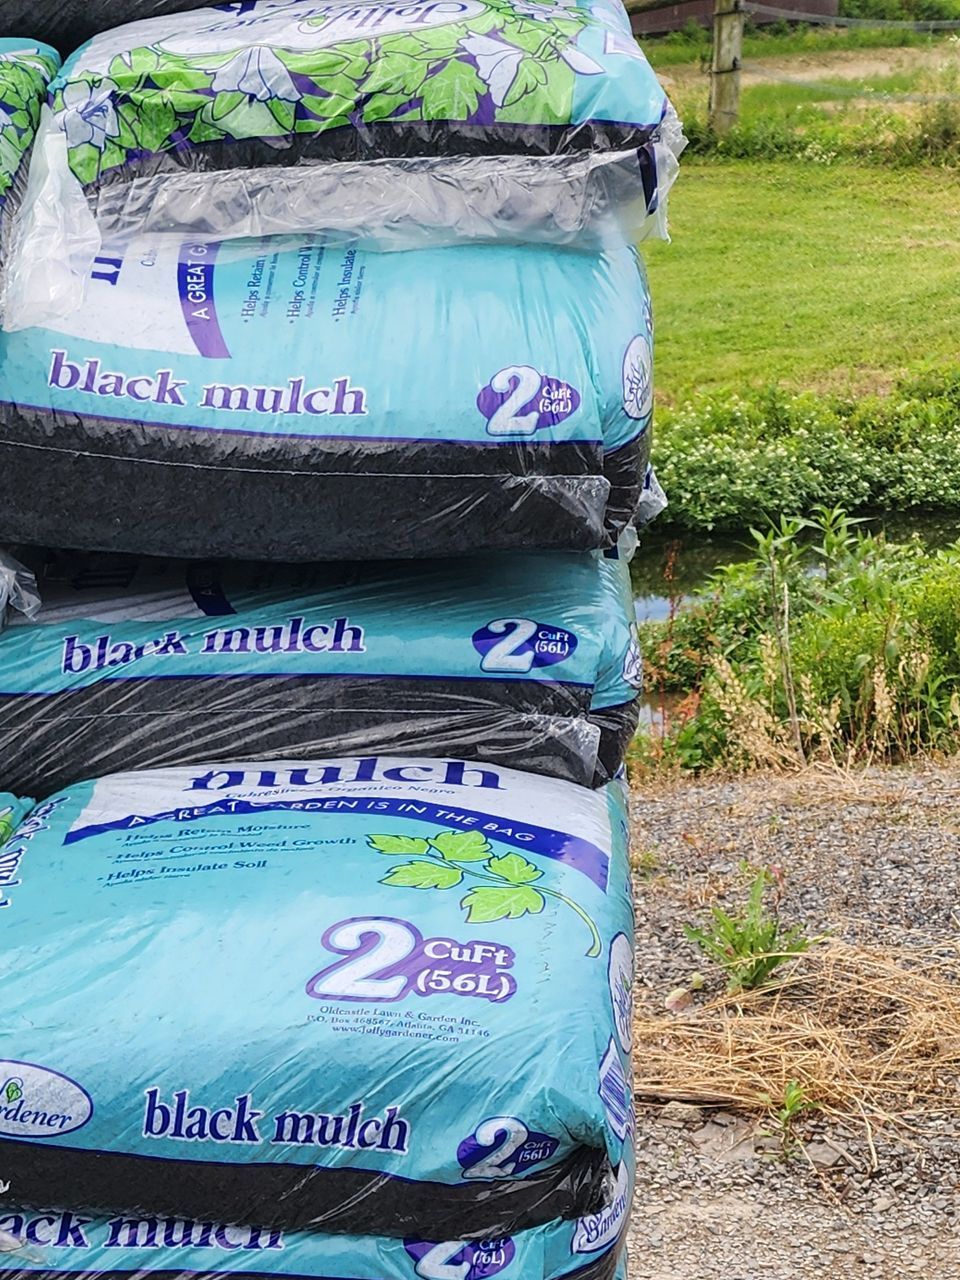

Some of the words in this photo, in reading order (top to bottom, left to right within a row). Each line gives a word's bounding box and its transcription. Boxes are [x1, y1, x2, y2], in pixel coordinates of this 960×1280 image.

[186, 259, 207, 303] GREAT
[247, 257, 267, 288] Retain
[292, 251, 312, 288] Control
[338, 249, 358, 287] Insulate
[191, 307, 210, 320] A
[241, 290, 260, 318] Helps
[287, 289, 305, 318] Helps
[332, 288, 351, 318] Helps
[46, 351, 187, 407] black
[198, 377, 368, 416] mulch
[541, 386, 572, 400] CuFt
[486, 365, 541, 437] 2
[538, 399, 573, 414] (56L)
[61, 634, 187, 675] black
[200, 616, 367, 655] mulch
[480, 617, 538, 674] 2
[534, 642, 571, 657] (56L)
[538, 631, 570, 643] CuFt
[182, 757, 507, 794] mulch
[127, 815, 146, 828] A
[366, 801, 389, 811] IS
[396, 802, 428, 814] IN
[434, 809, 481, 827] THE
[482, 822, 536, 843] BAG
[115, 848, 165, 862] Helps
[168, 842, 236, 855] Control
[290, 837, 358, 848] Growth
[106, 868, 157, 883] Helps
[158, 861, 229, 876] Insulate
[232, 859, 269, 870] Soil
[306, 916, 424, 1003] 2
[423, 940, 510, 967] CuFt
[416, 967, 511, 1000] (56L)
[319, 1005, 371, 1017] Oldcastle
[372, 1008, 403, 1019] Lawn
[404, 1010, 415, 1020] &
[417, 1012, 458, 1024] Garden
[460, 1016, 482, 1028] Inc.
[438, 1024, 455, 1034] GA
[143, 1088, 263, 1144] black
[271, 1101, 410, 1154] mulch
[461, 1116, 530, 1180] 2
